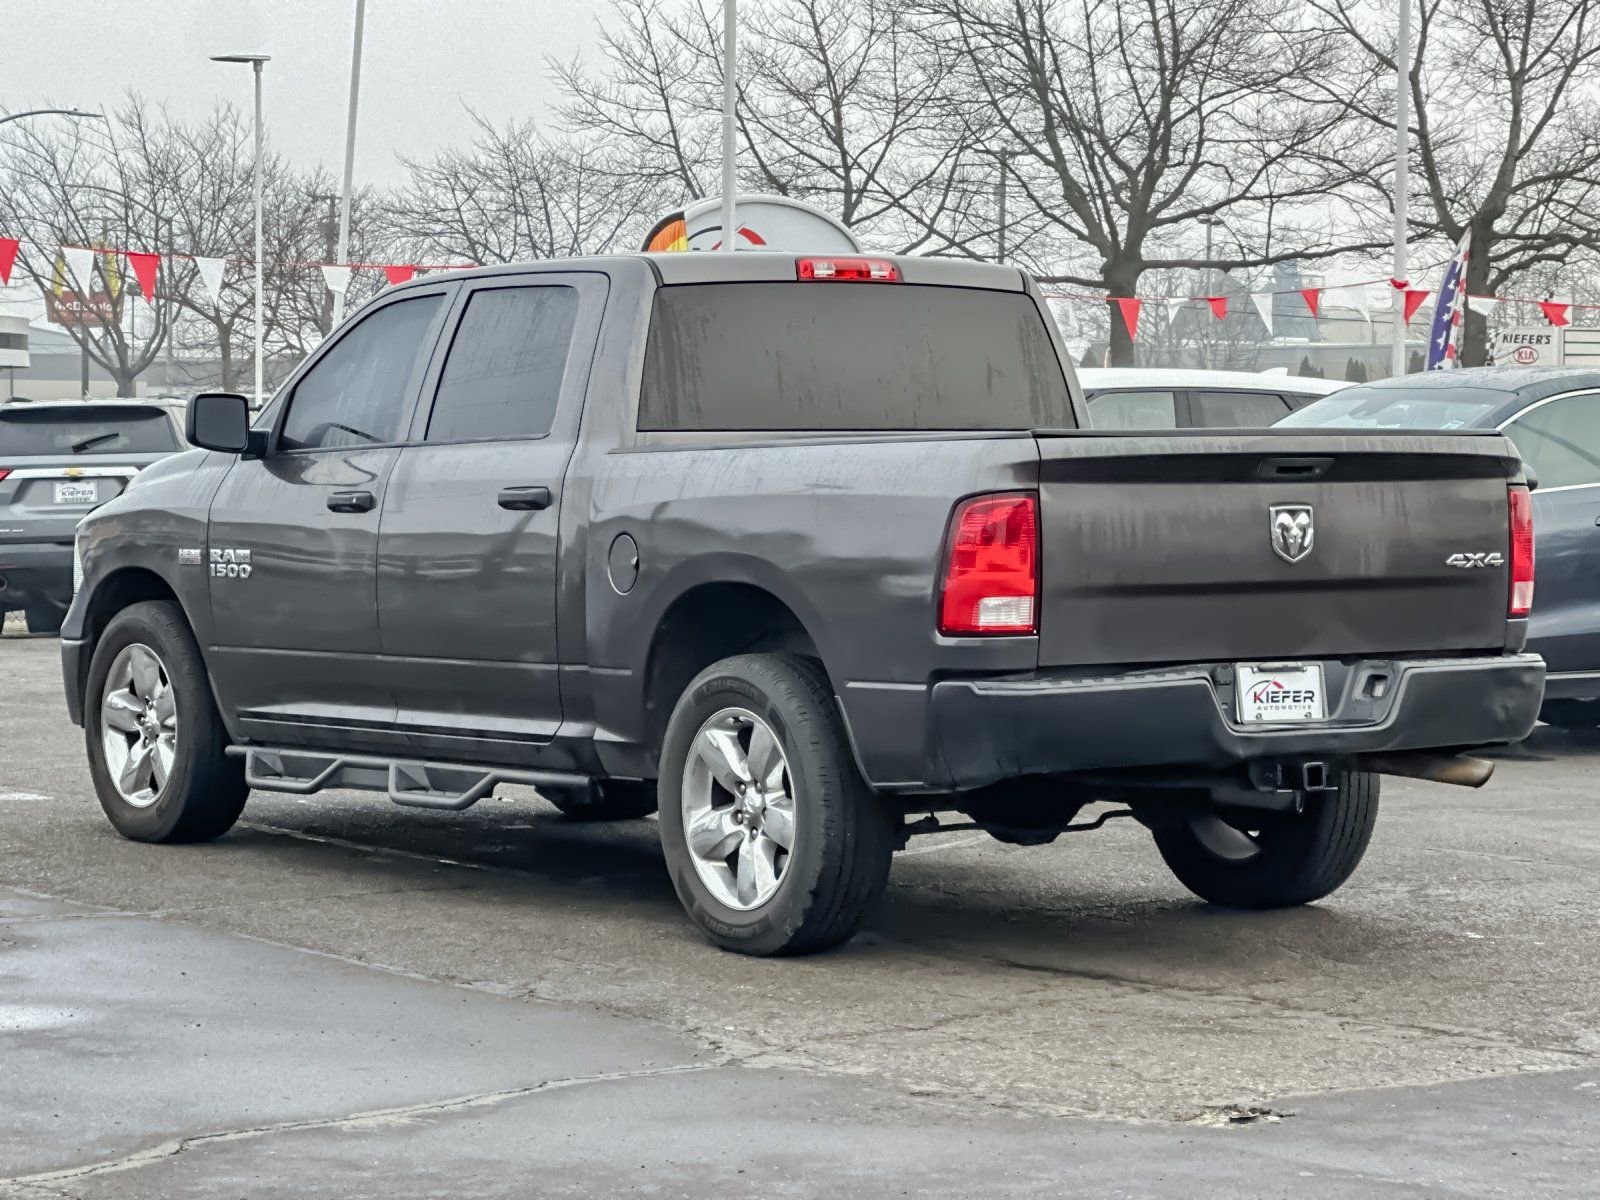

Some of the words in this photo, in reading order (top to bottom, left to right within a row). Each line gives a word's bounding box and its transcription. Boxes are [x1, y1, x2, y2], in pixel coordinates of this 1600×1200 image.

[1502, 333, 1552, 345] KIEFER'S
[1517, 350, 1535, 361] KIA
[209, 548, 251, 563] RAM
[209, 563, 252, 579] 1500
[1253, 689, 1315, 704] KIEFER
